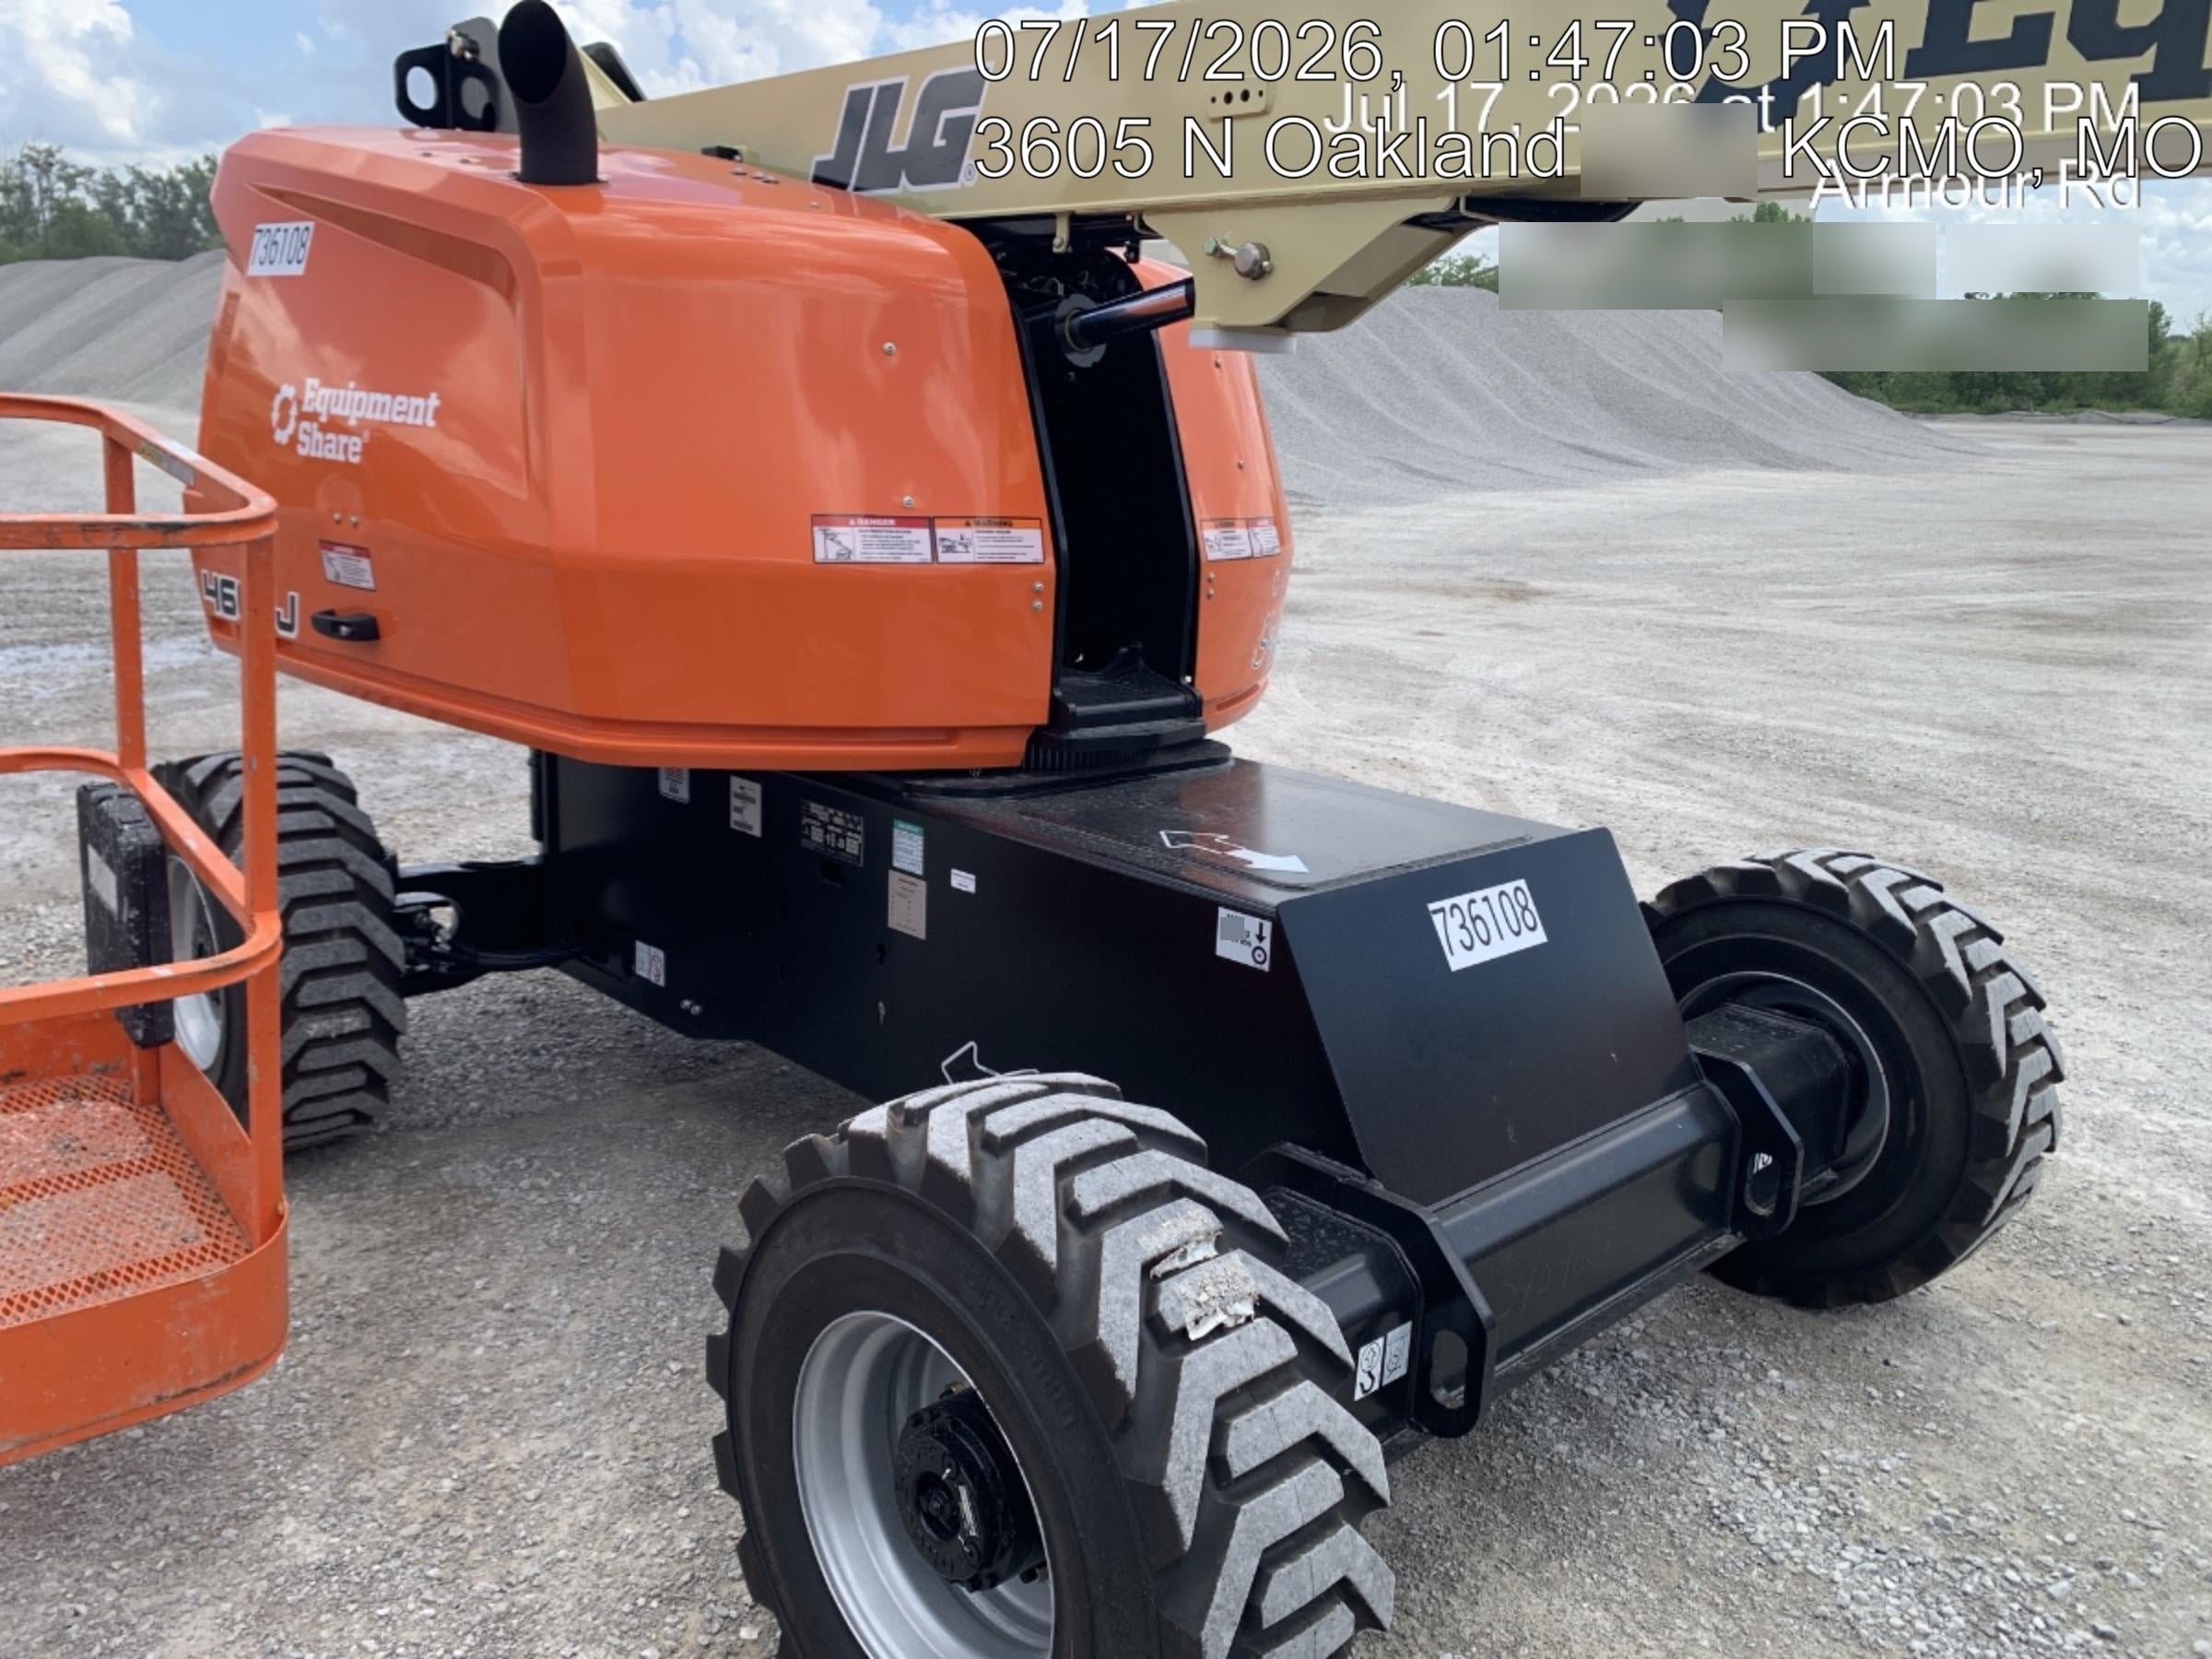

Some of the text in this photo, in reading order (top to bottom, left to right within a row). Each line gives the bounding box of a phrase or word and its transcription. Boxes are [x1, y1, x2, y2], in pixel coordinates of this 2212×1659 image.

[811, 62, 994, 195] JLG
[250, 226, 311, 266] 736108
[302, 377, 441, 428] Equipment
[296, 420, 363, 465] Share
[1430, 886, 1537, 957] 736108
